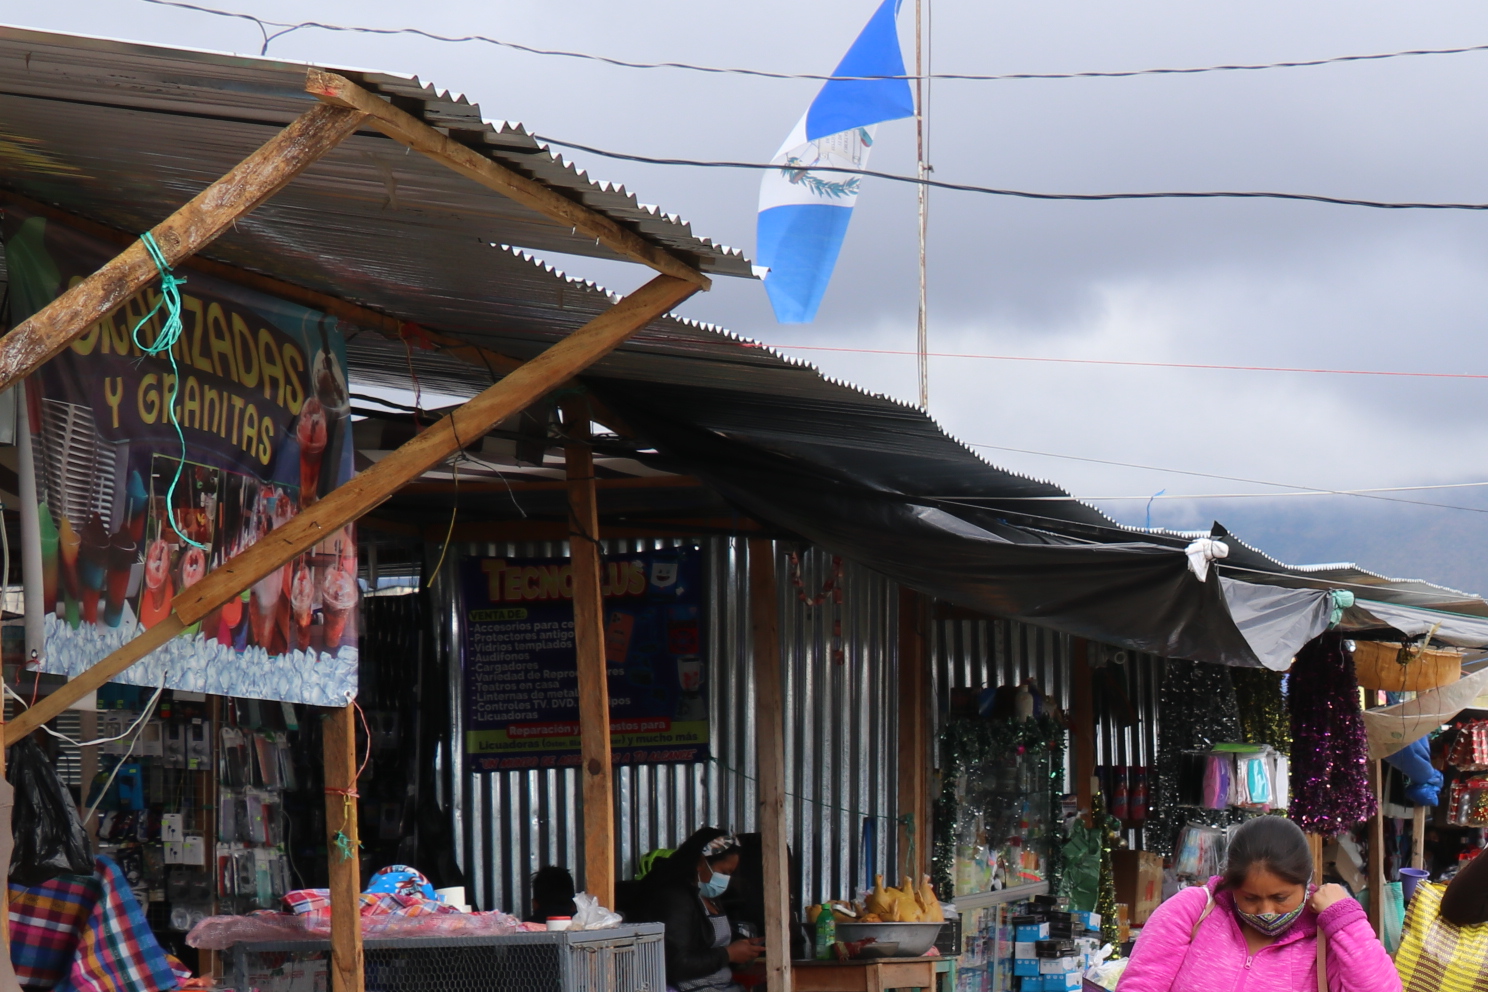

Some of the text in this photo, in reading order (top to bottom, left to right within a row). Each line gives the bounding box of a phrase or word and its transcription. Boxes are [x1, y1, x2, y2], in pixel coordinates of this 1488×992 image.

[104, 372, 275, 466] Y GRANITAS
[470, 608, 527, 621] VENTA DE:
[533, 622, 559, 632] para
[539, 630, 575, 640] antigo
[514, 640, 573, 651] templados
[526, 671, 541, 680] de
[518, 681, 533, 689] en
[535, 680, 560, 689] casa
[530, 690, 545, 699] de
[547, 688, 579, 698] metal
[533, 700, 550, 709] TV.
[552, 698, 578, 708] DVD.
[508, 724, 572, 737] Reparación
[572, 725, 580, 734] y
[641, 721, 666, 732] para
[478, 740, 540, 751] Licuadoras
[627, 736, 634, 747] y
[636, 732, 673, 743] mucho
[675, 730, 698, 742] más
